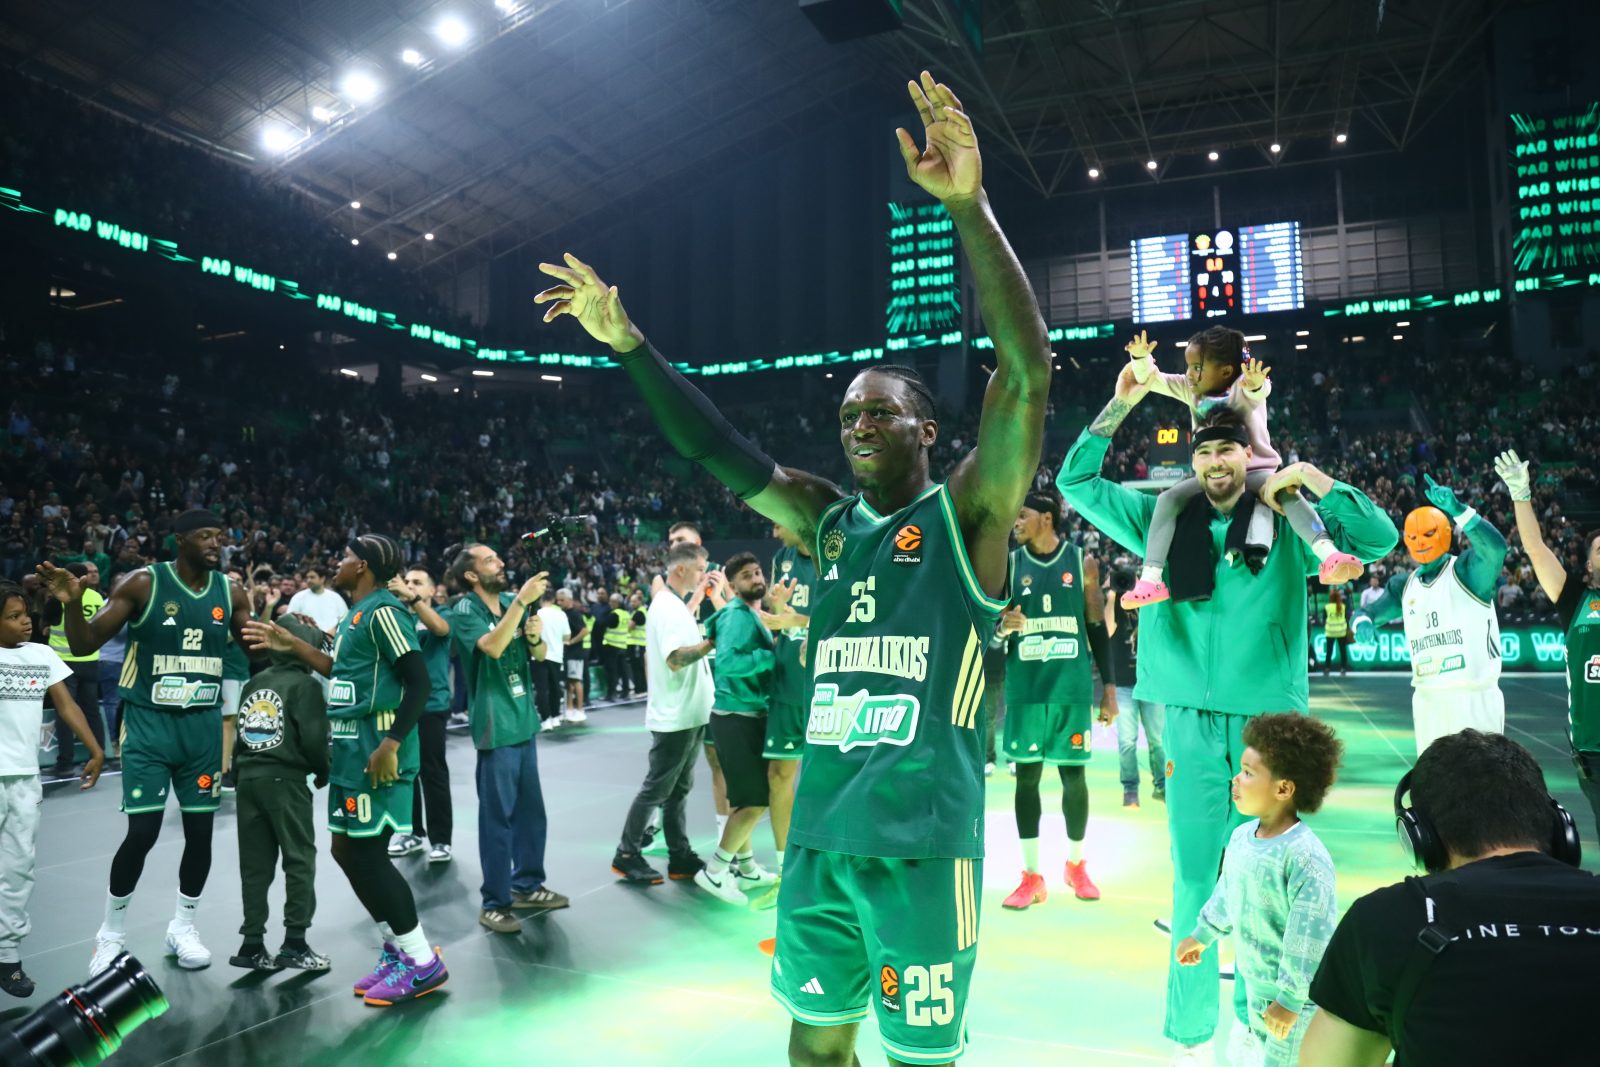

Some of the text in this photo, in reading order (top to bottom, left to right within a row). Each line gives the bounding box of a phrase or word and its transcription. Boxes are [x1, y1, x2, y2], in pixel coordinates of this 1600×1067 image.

[1157, 428, 1179, 444] 00
[791, 583, 809, 607] 20
[1043, 594, 1052, 613] 8
[182, 628, 203, 650] 22
[903, 961, 955, 1027] 25
